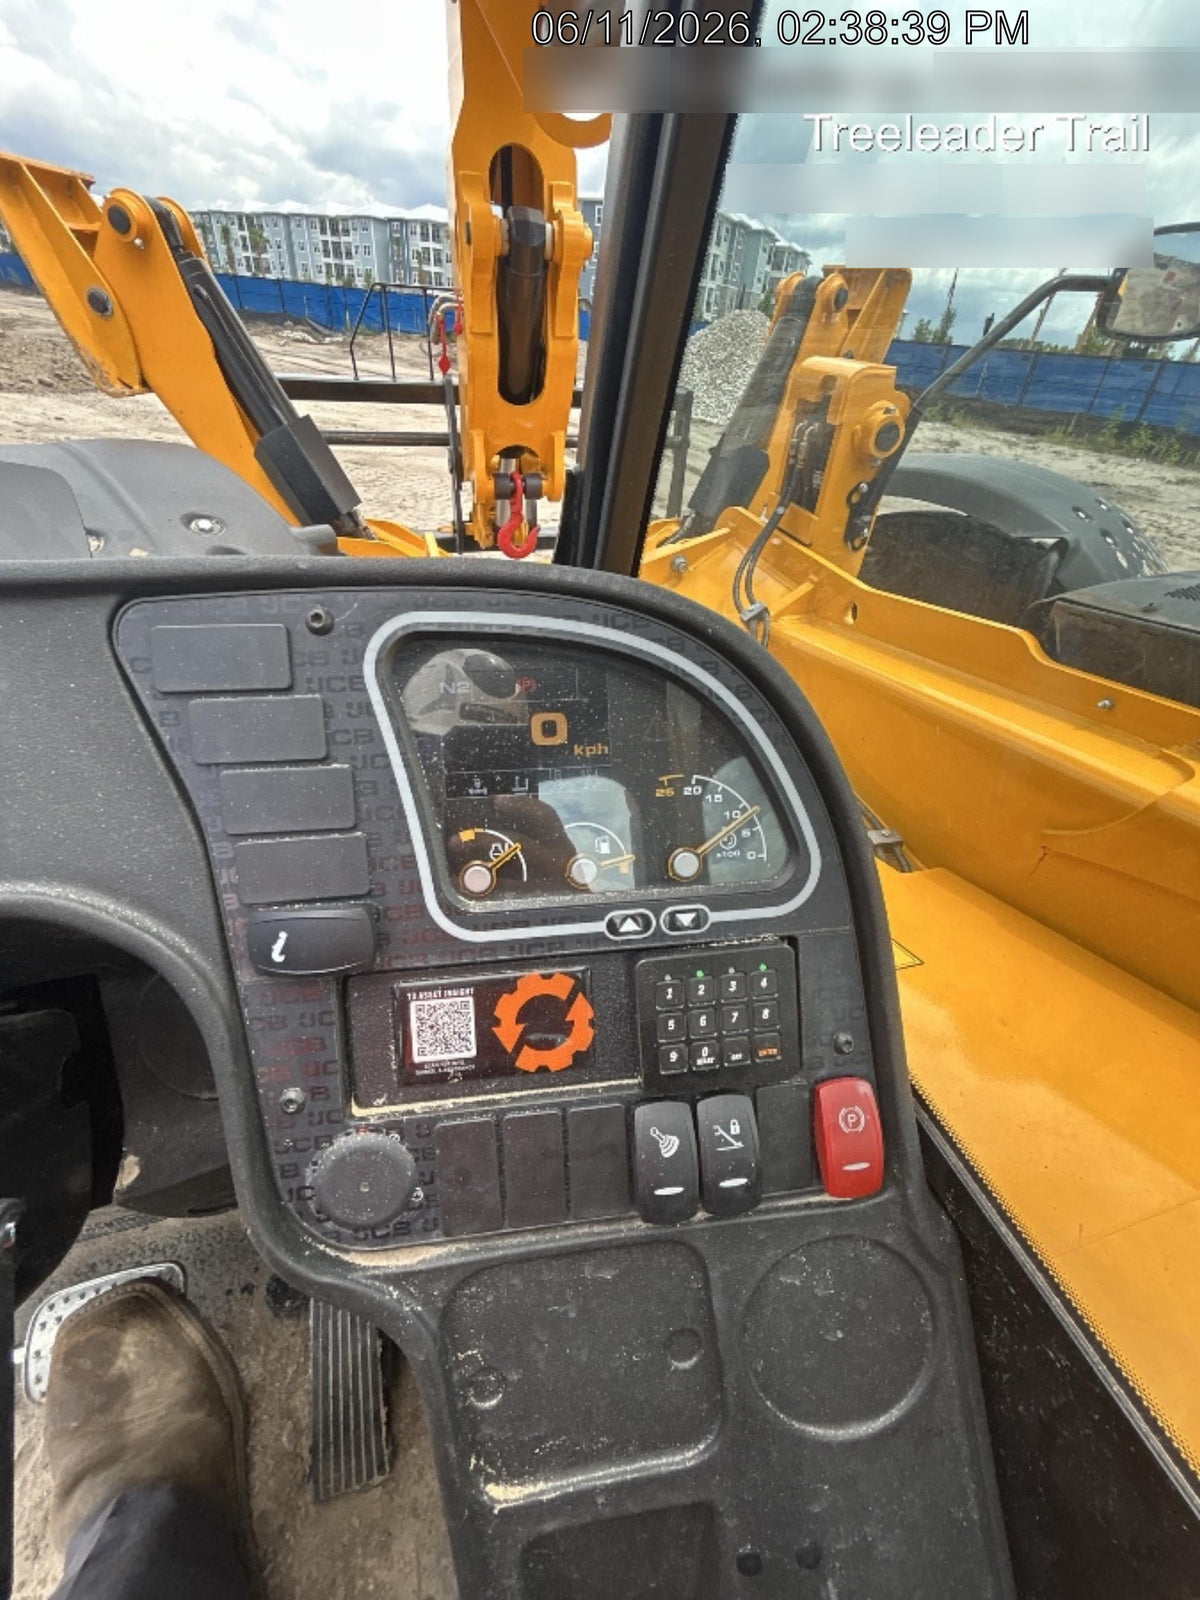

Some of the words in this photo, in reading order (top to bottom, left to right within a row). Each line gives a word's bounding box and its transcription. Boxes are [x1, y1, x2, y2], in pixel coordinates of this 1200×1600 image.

[439, 682, 472, 694] N2
[530, 712, 568, 746] 0
[573, 743, 610, 758] kph
[683, 785, 703, 796] 20
[723, 810, 741, 820] 10
[747, 851, 757, 860] 0
[728, 980, 737, 992] 3
[760, 977, 768, 988] 4
[666, 987, 673, 999] 1
[698, 984, 705, 995] 2
[731, 1011, 739, 1023] 7
[762, 1008, 770, 1019] 8
[667, 1019, 675, 1030] 5
[700, 1015, 707, 1026] 6
[669, 1051, 678, 1062] 9
[701, 1046, 709, 1057] 0
